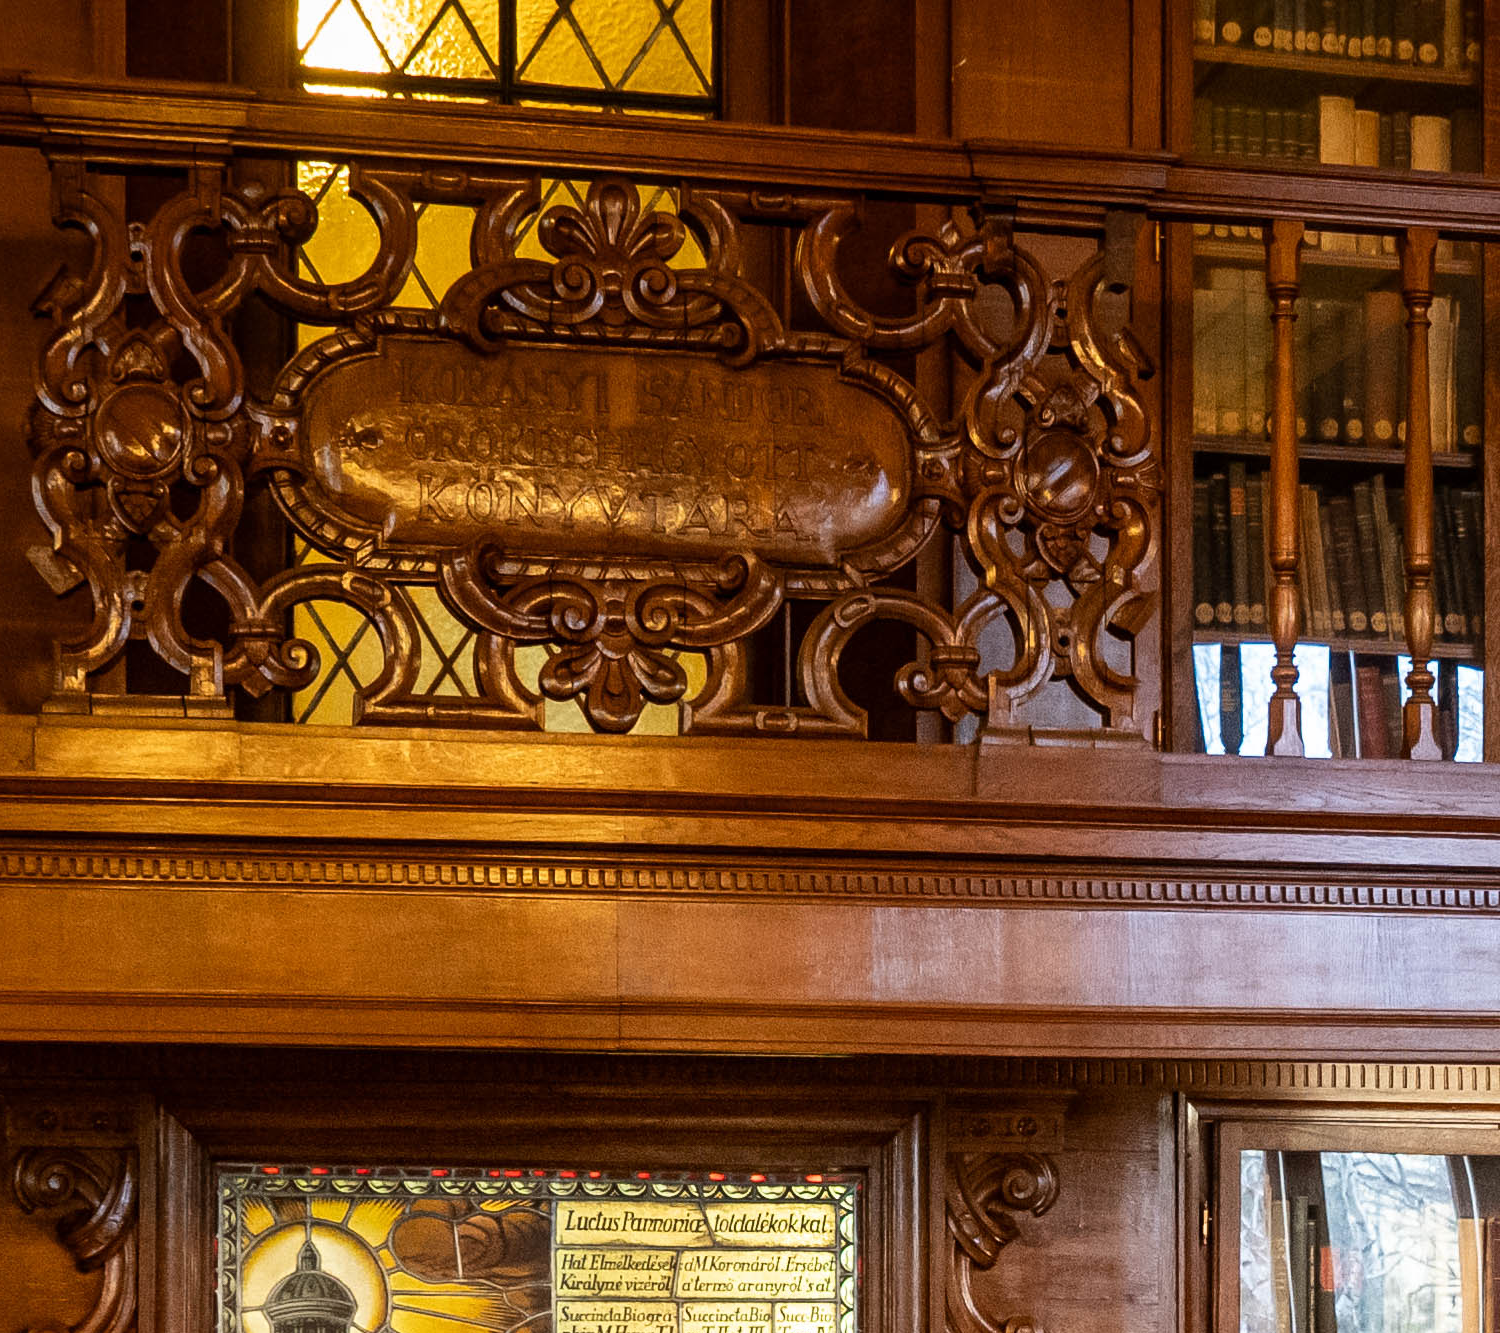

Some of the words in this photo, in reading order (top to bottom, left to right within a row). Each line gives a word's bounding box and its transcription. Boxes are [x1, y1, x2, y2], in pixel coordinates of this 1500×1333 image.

[565, 1210, 620, 1231] Luctus
[561, 1254, 587, 1270] Hat
[560, 1273, 623, 1295] Királyné
[738, 1276, 802, 1296] aranyról
